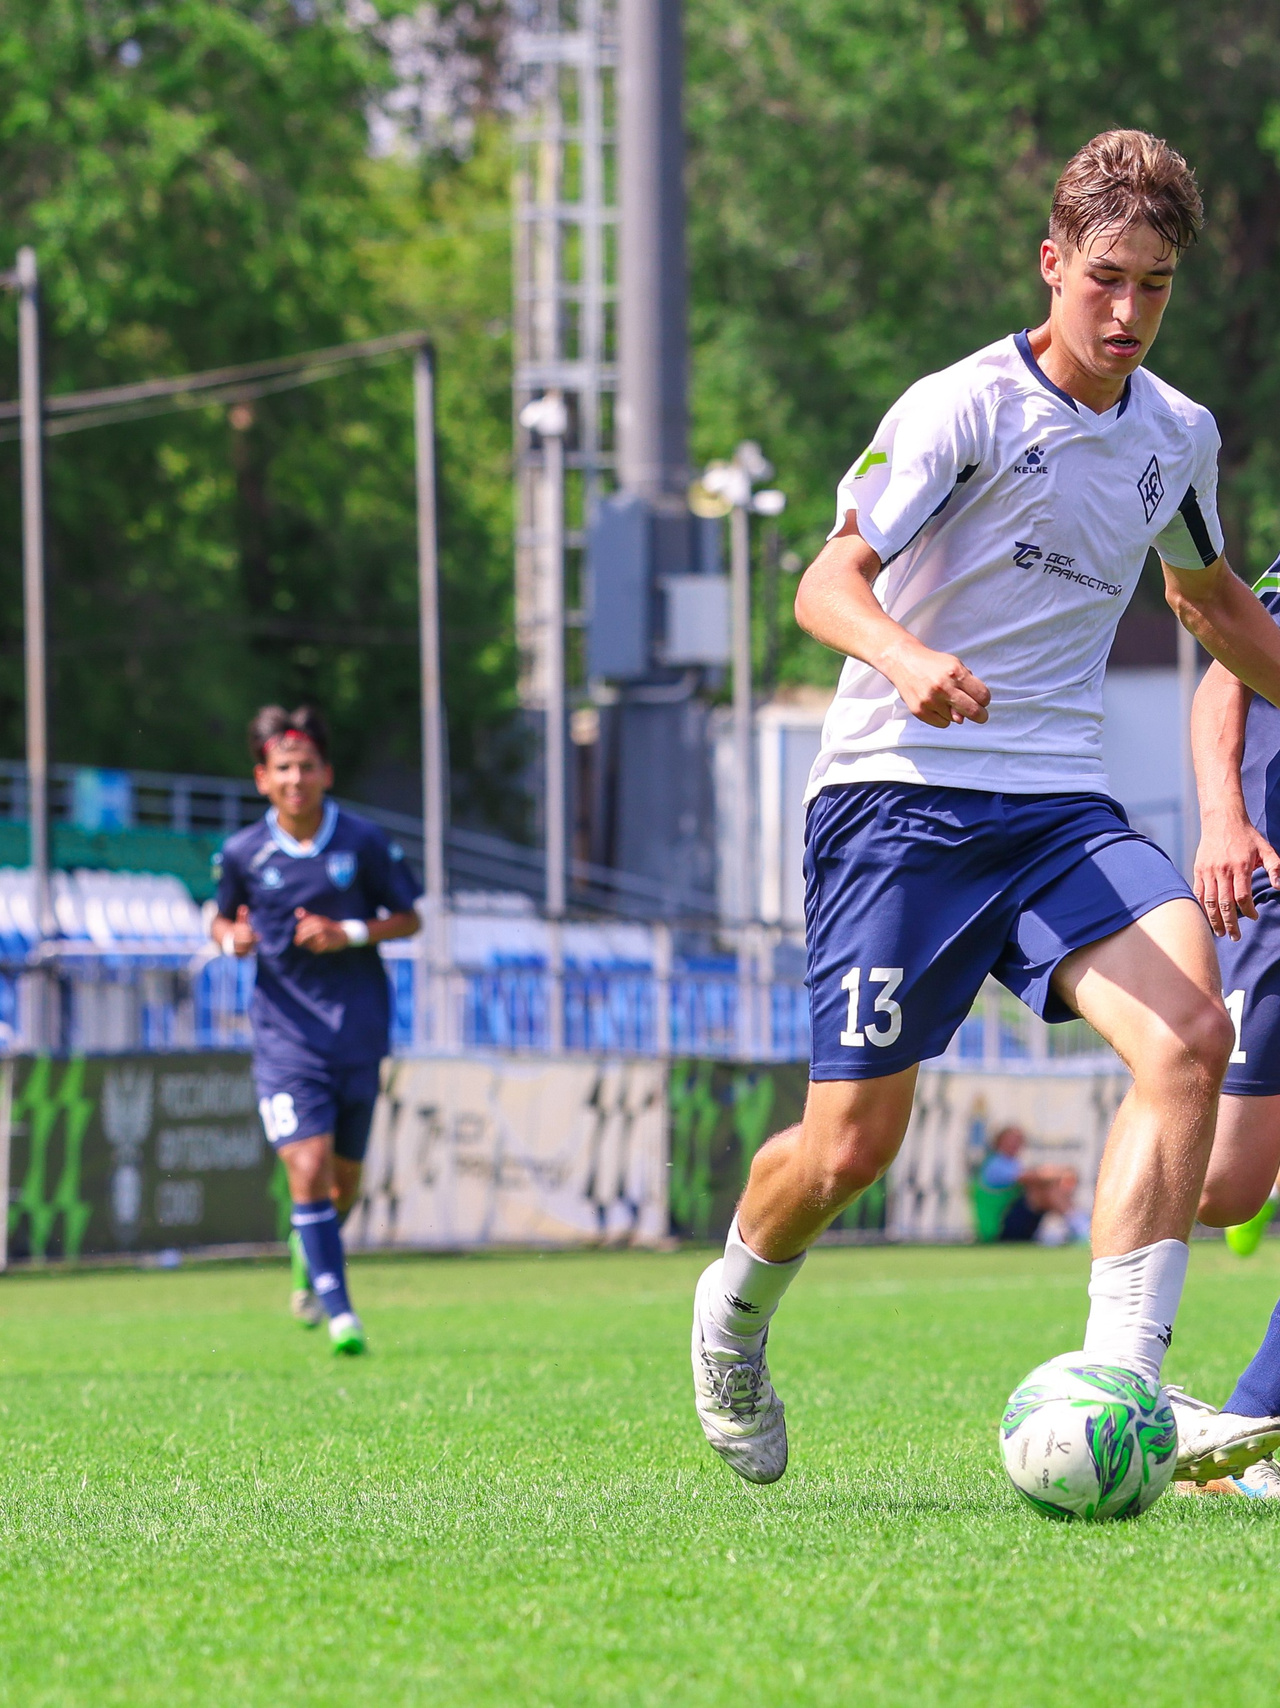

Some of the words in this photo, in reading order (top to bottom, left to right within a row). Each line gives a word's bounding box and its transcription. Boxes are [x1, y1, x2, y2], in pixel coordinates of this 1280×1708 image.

[1014, 466, 1048, 474] KELME
[1045, 552, 1076, 568] ДСК
[1043, 564, 1123, 597] ТРАНССТРОЙ
[840, 967, 904, 1048] 13
